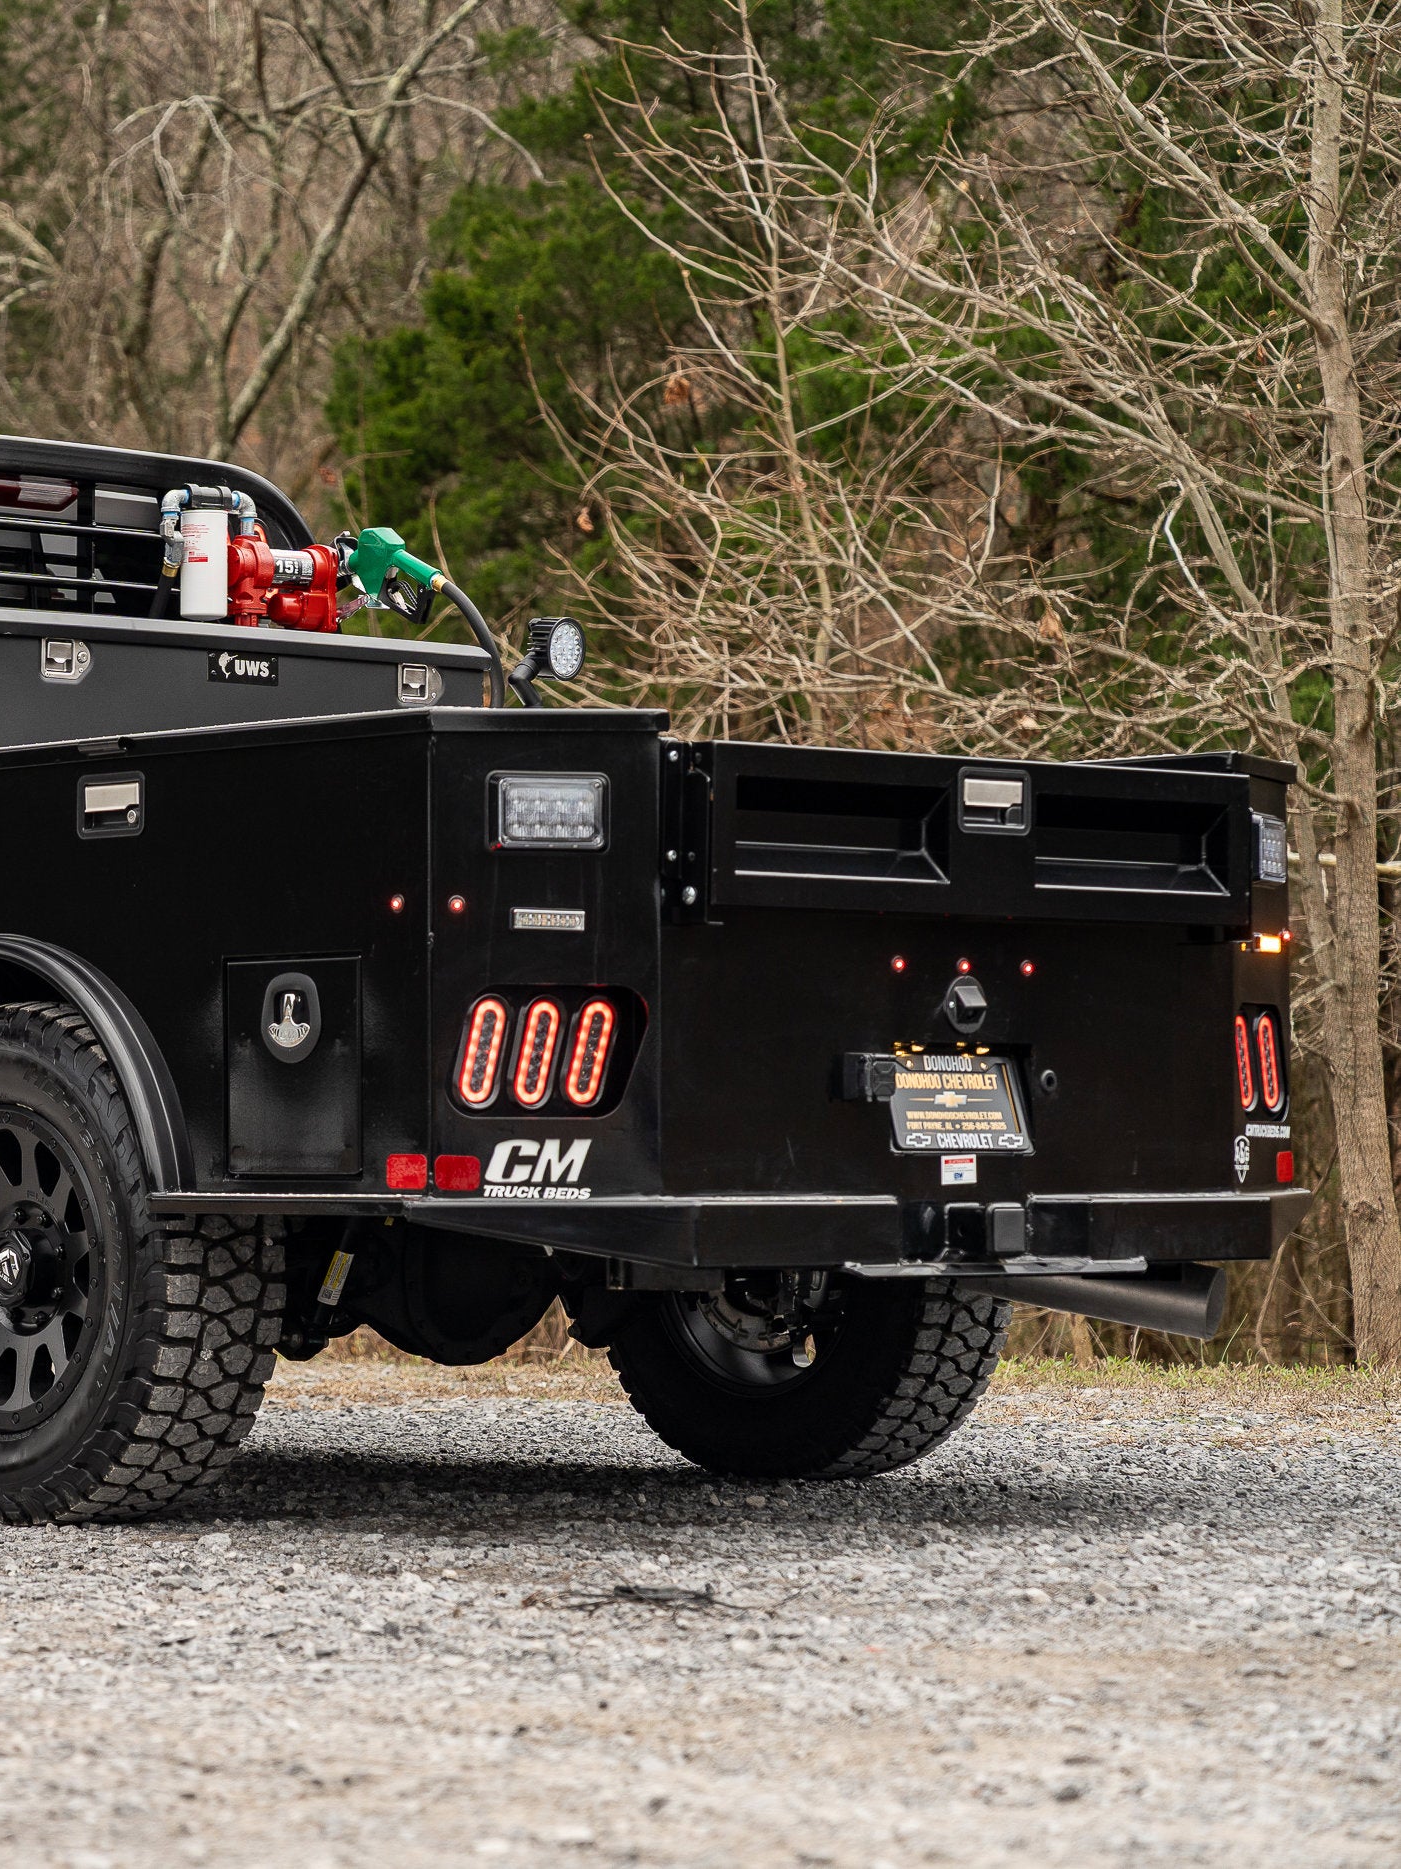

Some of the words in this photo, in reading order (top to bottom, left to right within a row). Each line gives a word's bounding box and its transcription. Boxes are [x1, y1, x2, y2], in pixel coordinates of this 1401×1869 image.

[234, 659, 270, 678] UWS
[923, 1055, 973, 1072] DONOHOO
[895, 1072, 942, 1089] DONOHOO
[942, 1073, 998, 1090] CHEVROLET
[937, 1132, 994, 1149] CHEVROLET
[484, 1138, 592, 1184] CM
[483, 1185, 542, 1199] TRUCK
[543, 1186, 592, 1200] BEDS
